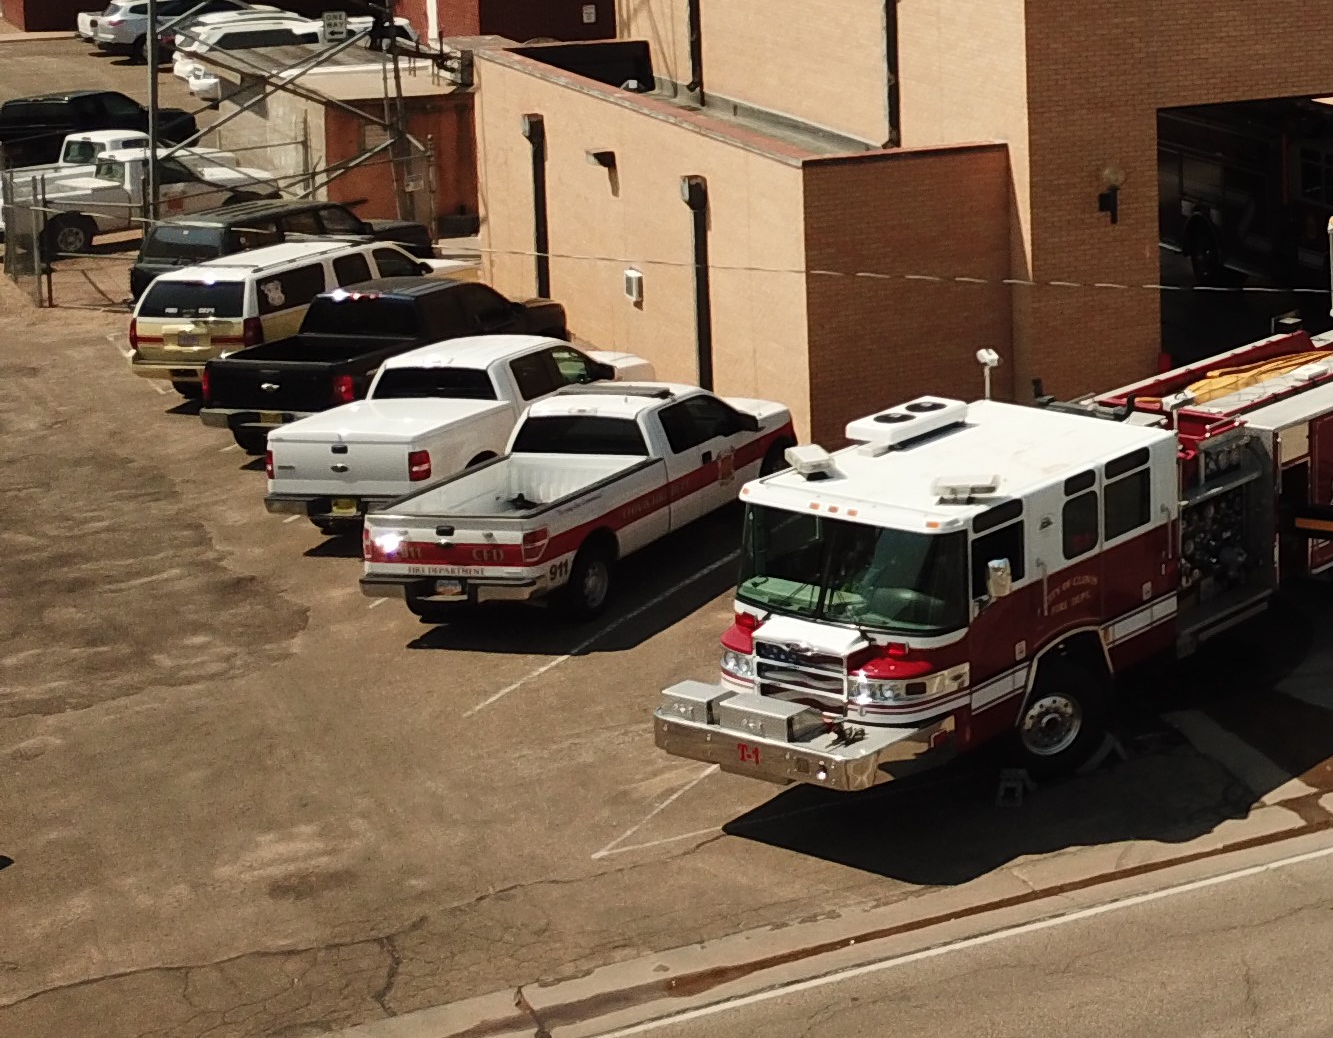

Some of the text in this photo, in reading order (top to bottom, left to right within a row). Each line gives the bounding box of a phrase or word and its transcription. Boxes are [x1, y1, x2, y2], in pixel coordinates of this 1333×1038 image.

[472, 548, 504, 562] CFD
[549, 559, 569, 581] 911
[737, 743, 760, 765] T-1
